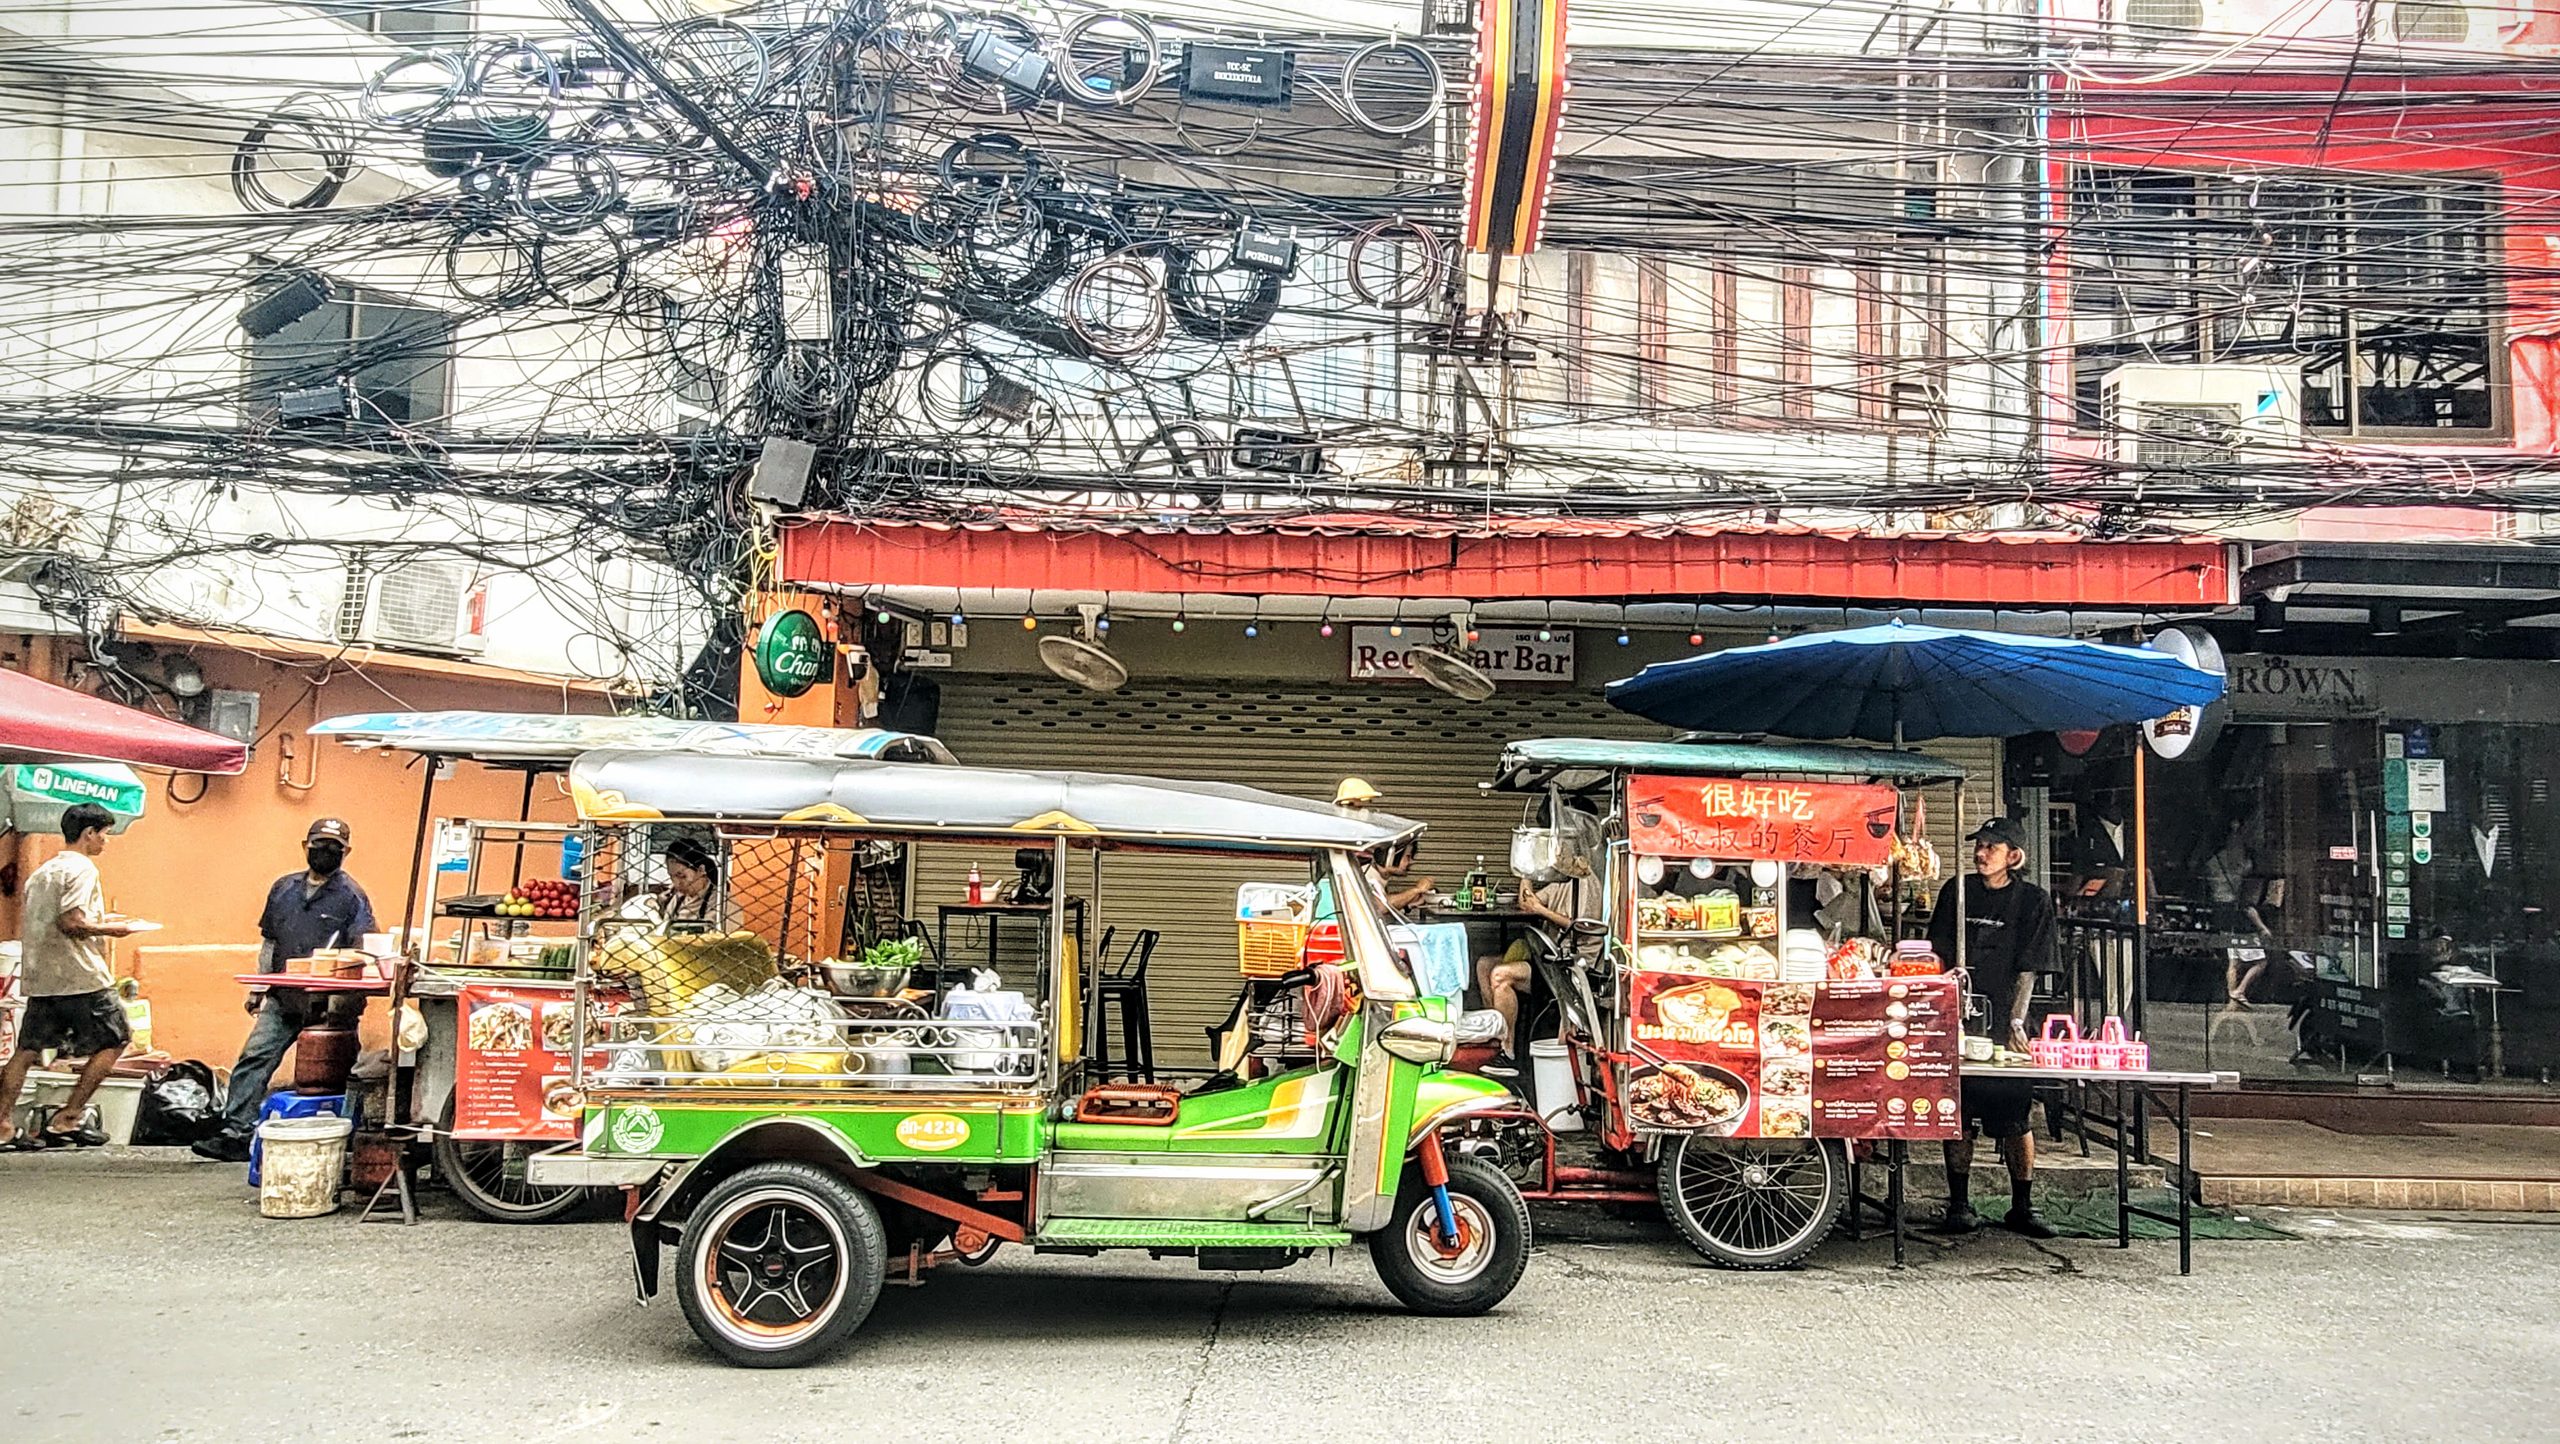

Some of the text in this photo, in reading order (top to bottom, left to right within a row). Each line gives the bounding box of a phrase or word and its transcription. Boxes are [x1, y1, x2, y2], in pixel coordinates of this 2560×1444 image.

[775, 651, 818, 676] Chan
[1514, 645, 1570, 673] Bar
[2237, 666, 2358, 695] ROWN
[1702, 783, 1815, 821] 很好吃
[1672, 820, 1855, 858] 叔叔的餐厅
